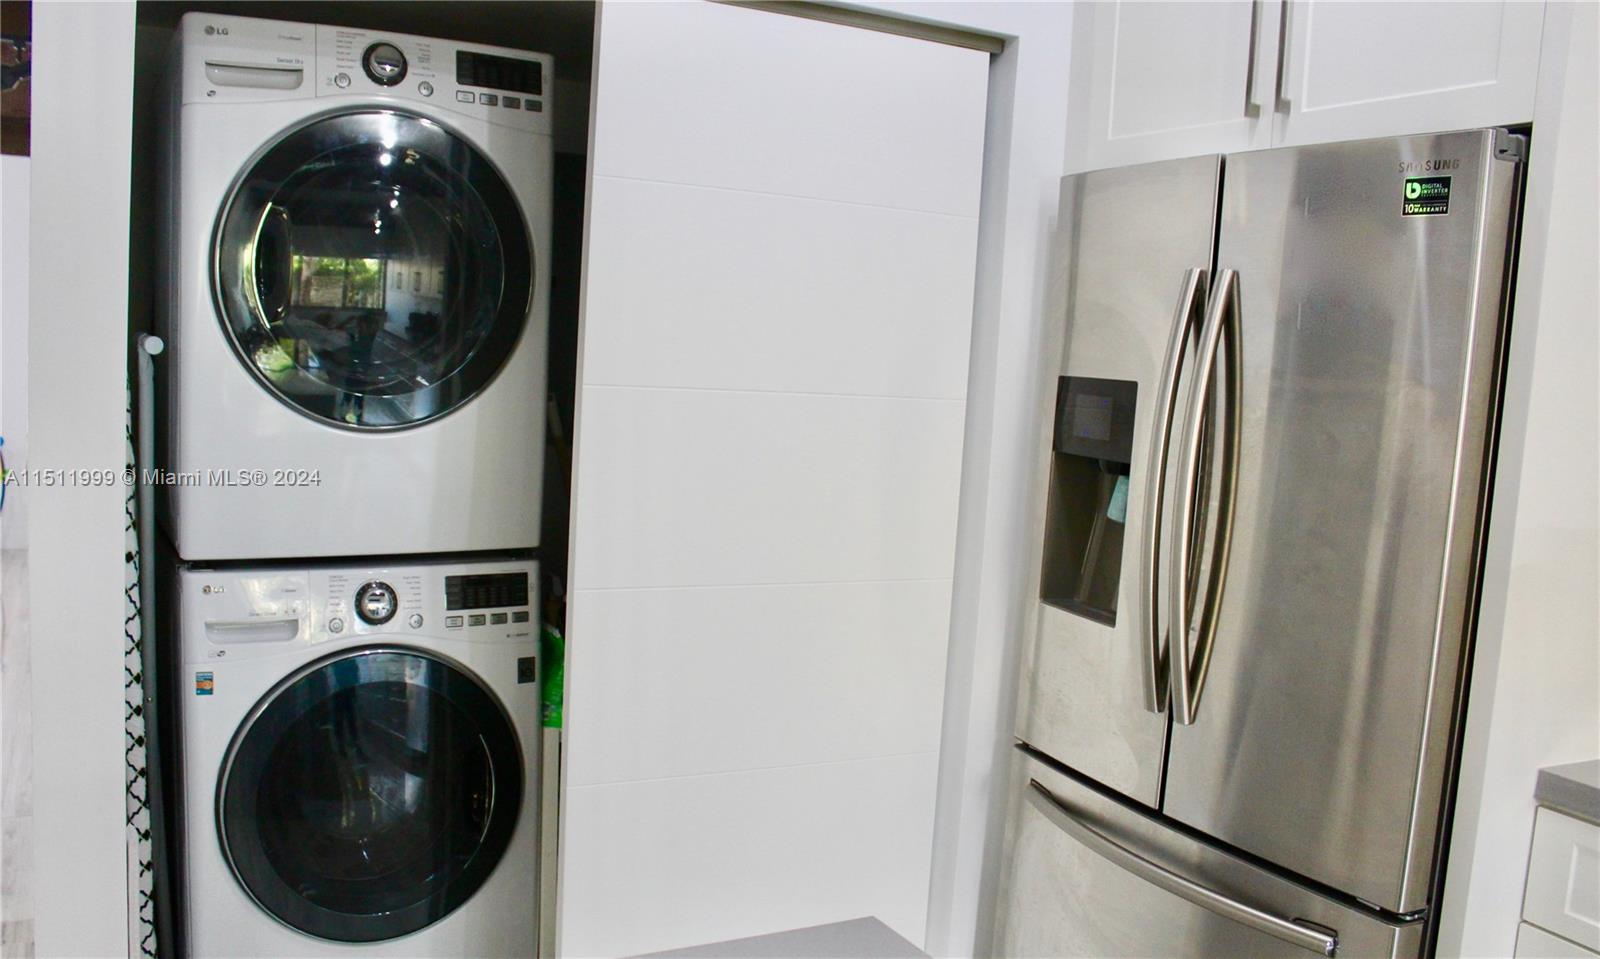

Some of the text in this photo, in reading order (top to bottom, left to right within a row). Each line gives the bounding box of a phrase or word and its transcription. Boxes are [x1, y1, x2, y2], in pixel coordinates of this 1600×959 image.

[216, 27, 229, 36] LG
[1398, 159, 1460, 173] SAMSUNG
[1404, 203, 1414, 213] 10
